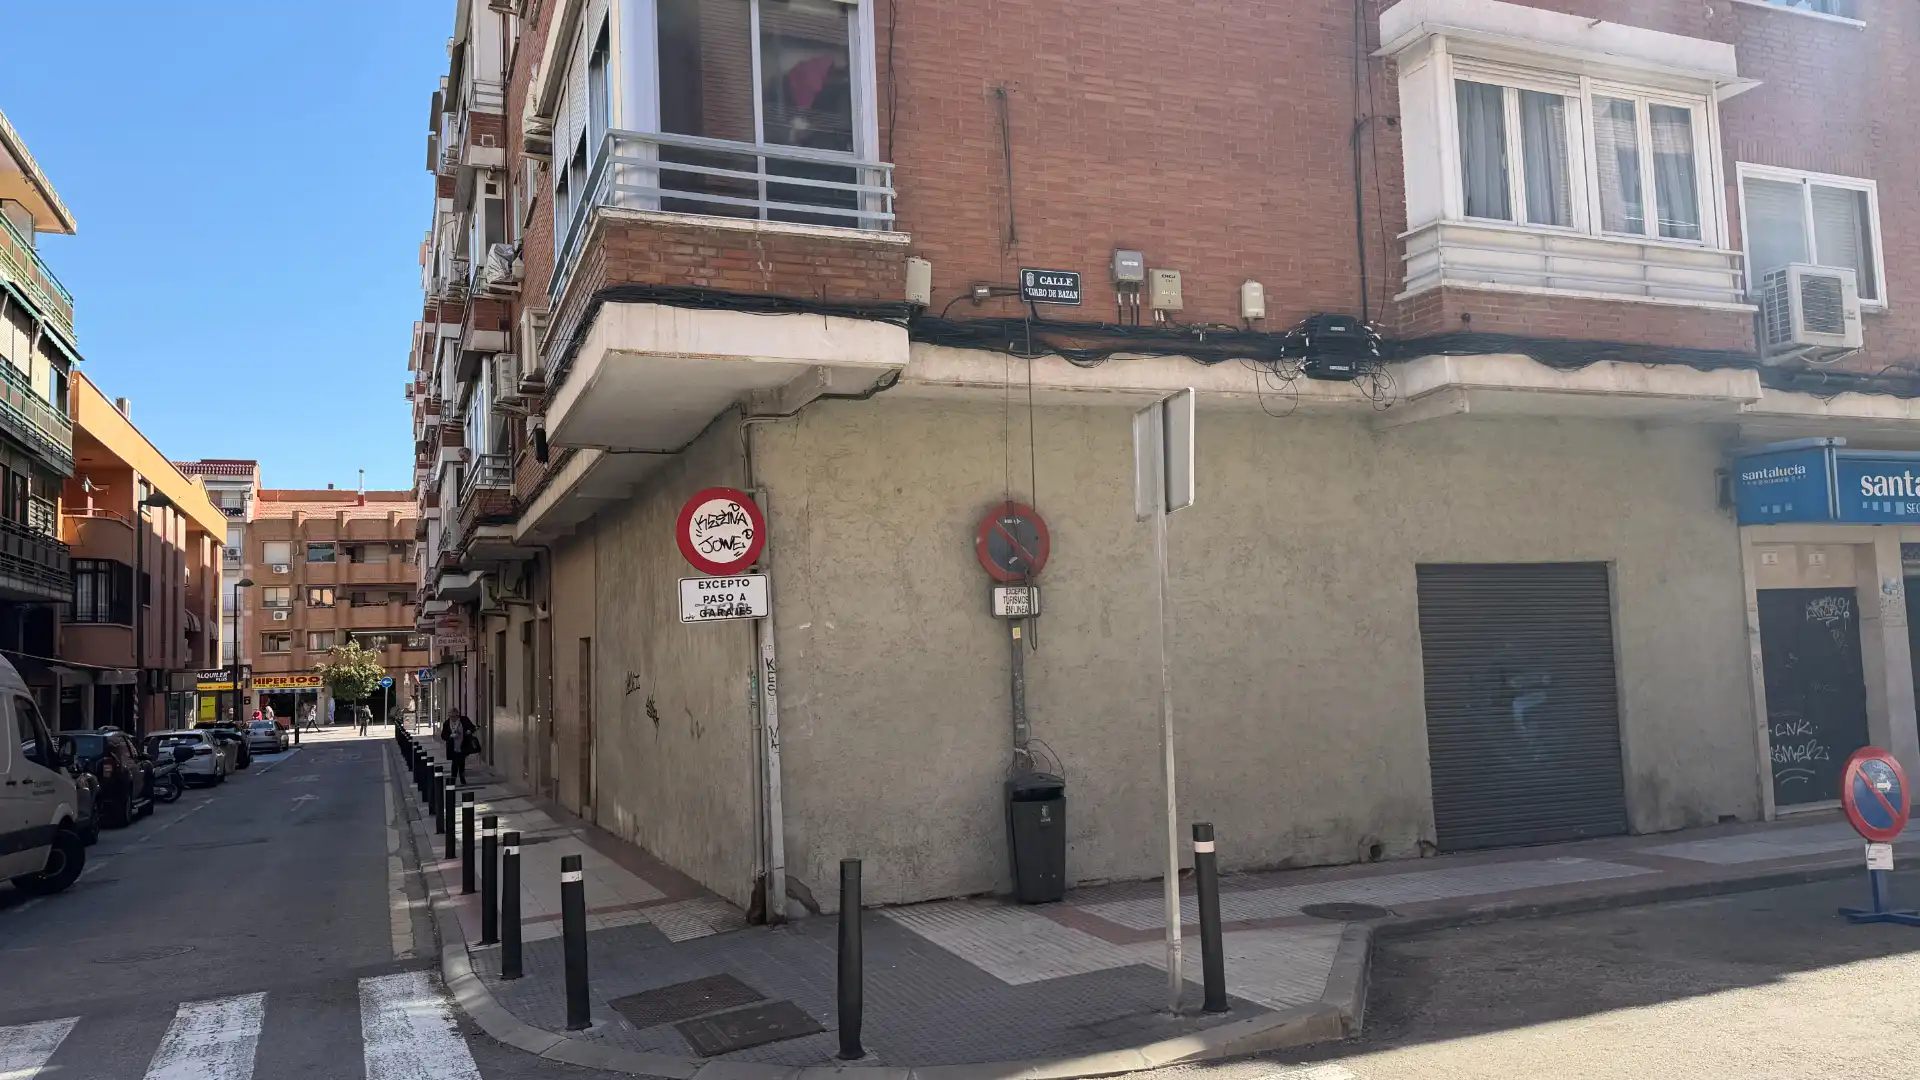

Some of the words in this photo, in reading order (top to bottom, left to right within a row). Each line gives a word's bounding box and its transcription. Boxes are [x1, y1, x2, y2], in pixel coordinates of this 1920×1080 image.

[1039, 276, 1073, 287] CALLE
[1048, 289, 1057, 299] DE
[1058, 290, 1079, 299] BAZAN
[1741, 464, 1806, 481] santalucía
[698, 578, 750, 590] EXCEPTO
[703, 593, 734, 604] PASO
[739, 592, 747, 602] A
[1006, 605, 1013, 614] EN
[253, 677, 288, 685] HIPER
